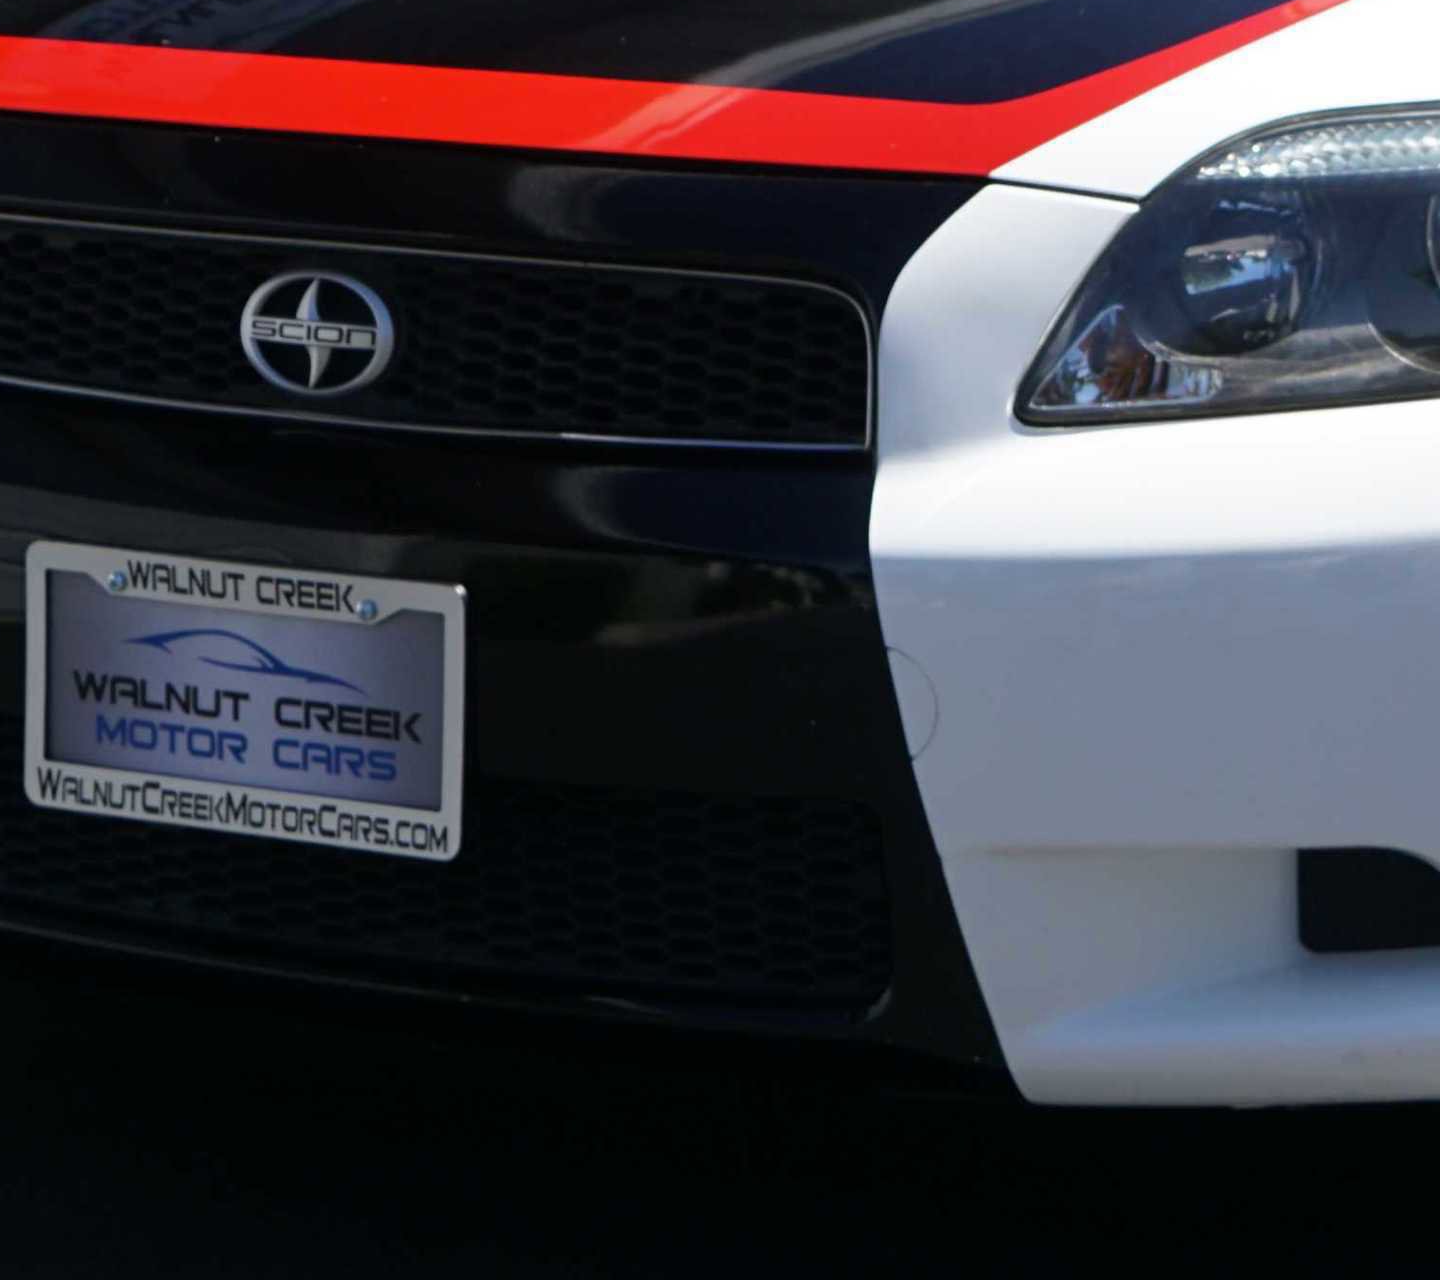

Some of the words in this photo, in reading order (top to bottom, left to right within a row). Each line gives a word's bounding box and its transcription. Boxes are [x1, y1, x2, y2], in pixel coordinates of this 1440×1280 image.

[250, 319, 377, 346] SCION
[126, 559, 245, 602] WALNUT
[256, 575, 354, 615] CREEK
[73, 669, 250, 721] WALNUT
[273, 695, 424, 744] CREEK
[94, 713, 248, 764] MOTOR
[272, 738, 398, 782] CARS
